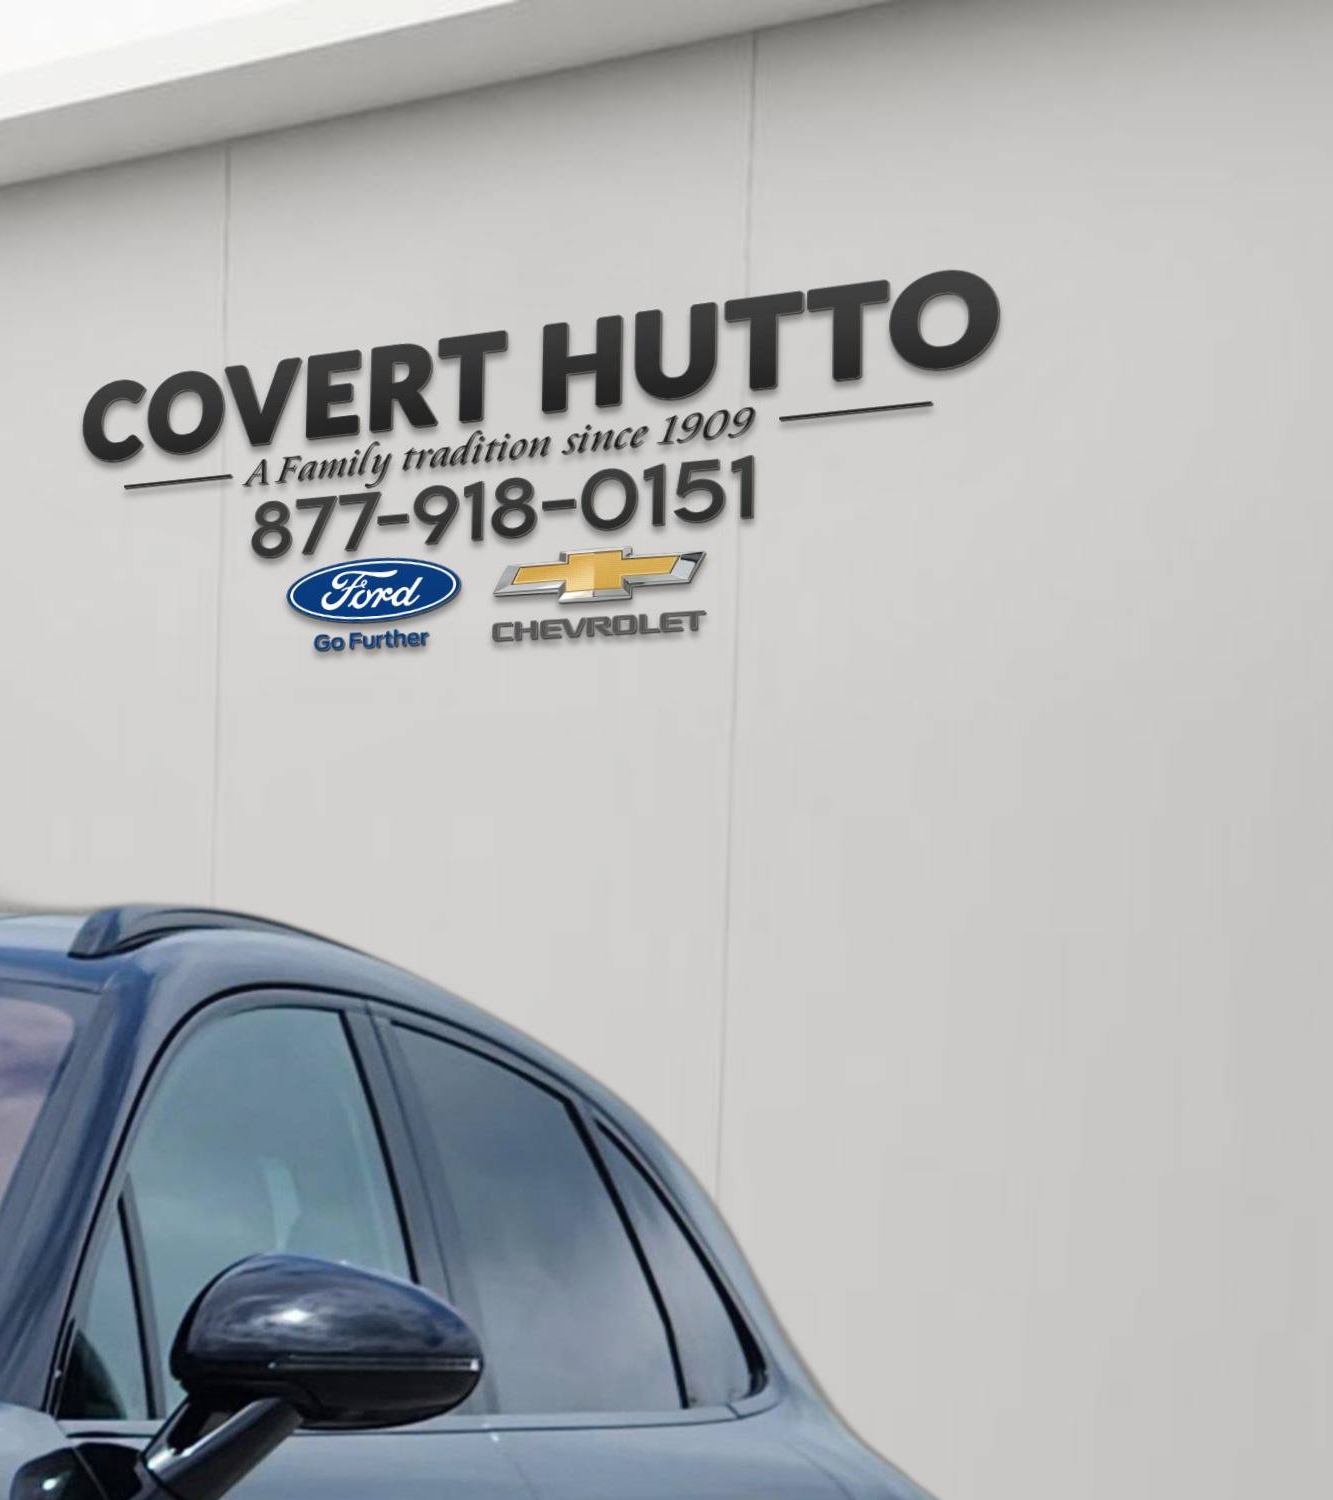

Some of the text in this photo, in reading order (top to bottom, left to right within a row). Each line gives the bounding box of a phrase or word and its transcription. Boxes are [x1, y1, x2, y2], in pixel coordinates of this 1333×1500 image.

[82, 269, 1001, 463] COVERT HUTTO
[243, 407, 755, 487] A Family tradition since 1909
[250, 455, 755, 558] 877-918-0151
[321, 569, 423, 610] Ford
[313, 629, 429, 652] Go Further
[491, 610, 707, 643] CHEVROLET
